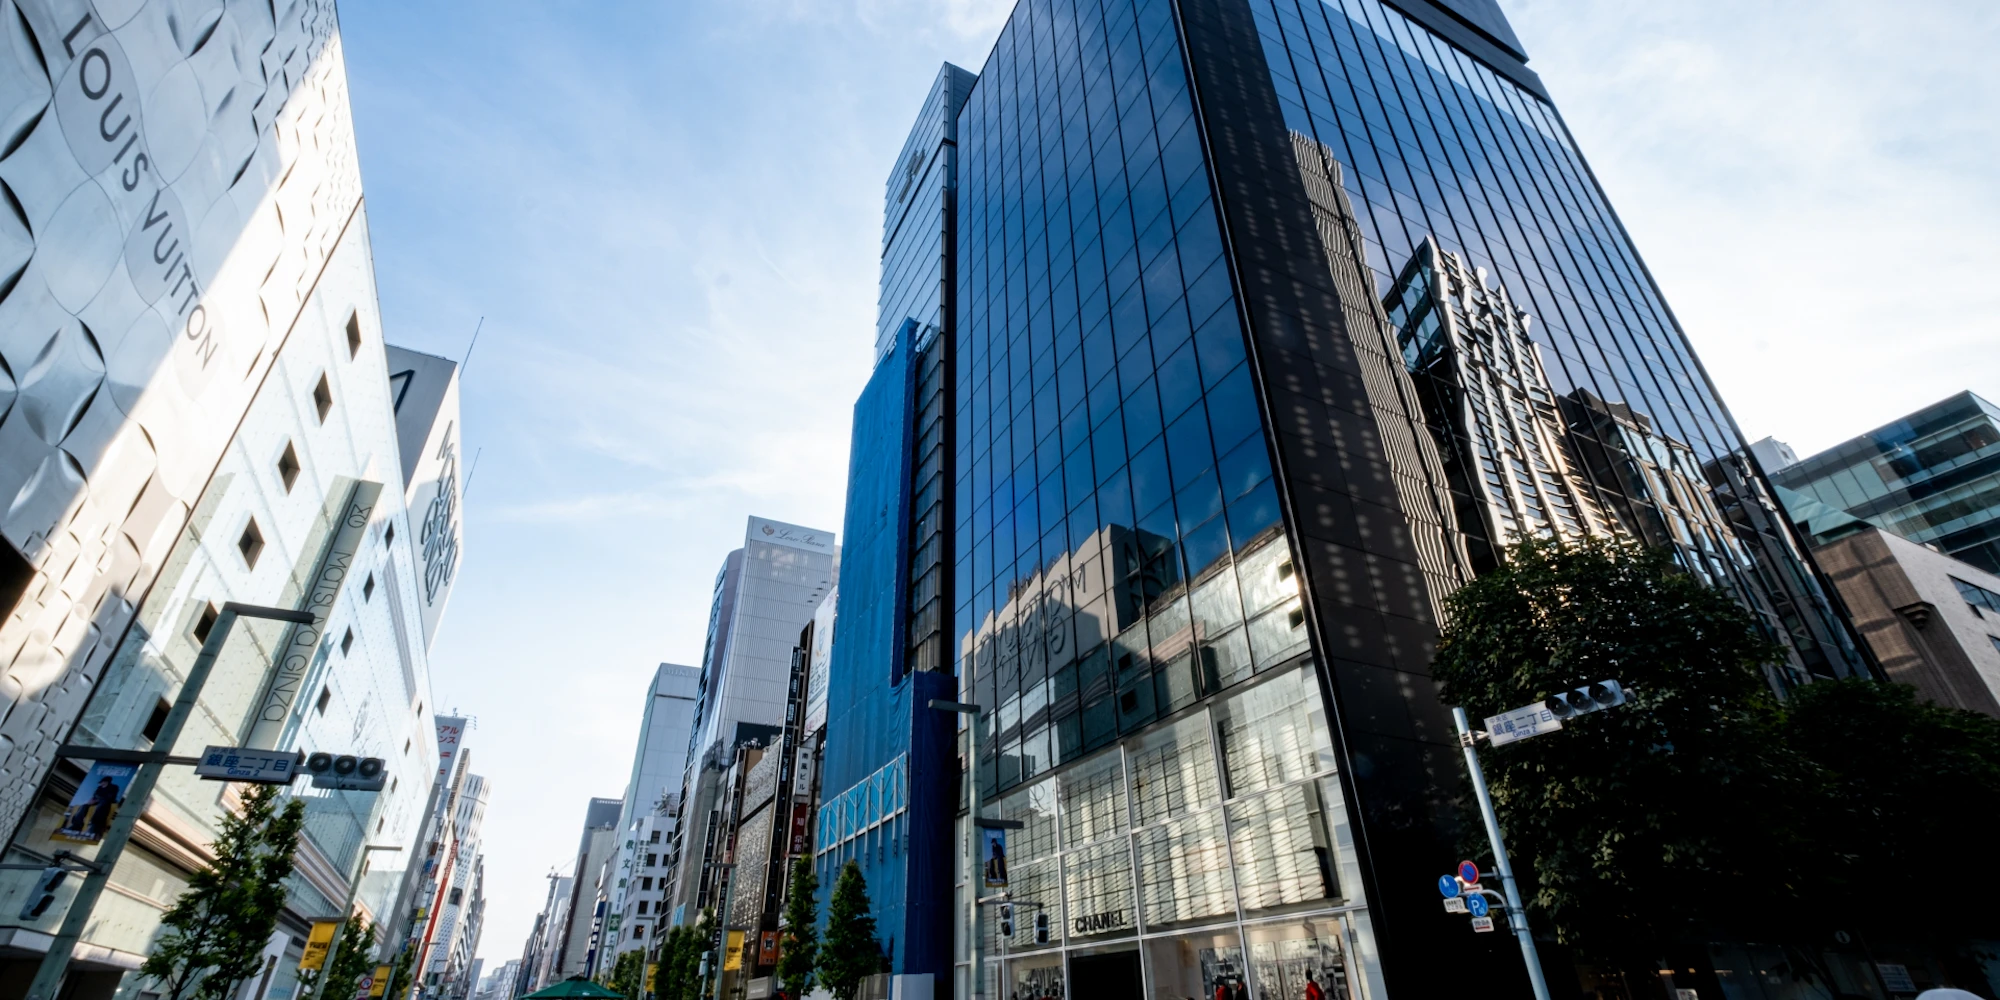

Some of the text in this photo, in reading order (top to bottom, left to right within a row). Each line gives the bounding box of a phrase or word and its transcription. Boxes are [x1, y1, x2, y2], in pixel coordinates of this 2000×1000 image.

[62, 13, 219, 371] LOUIS VUITTON
[775, 527, 827, 549] Loro Piana
[1492, 709, 1553, 737] 銀座二丁目
[1512, 725, 1537, 738] Ginza 2
[205, 753, 289, 772] 銀座二丁目
[227, 767, 260, 777] Ginza 2
[1471, 899, 1480, 915] P
[1075, 909, 1128, 933] CHANEL
